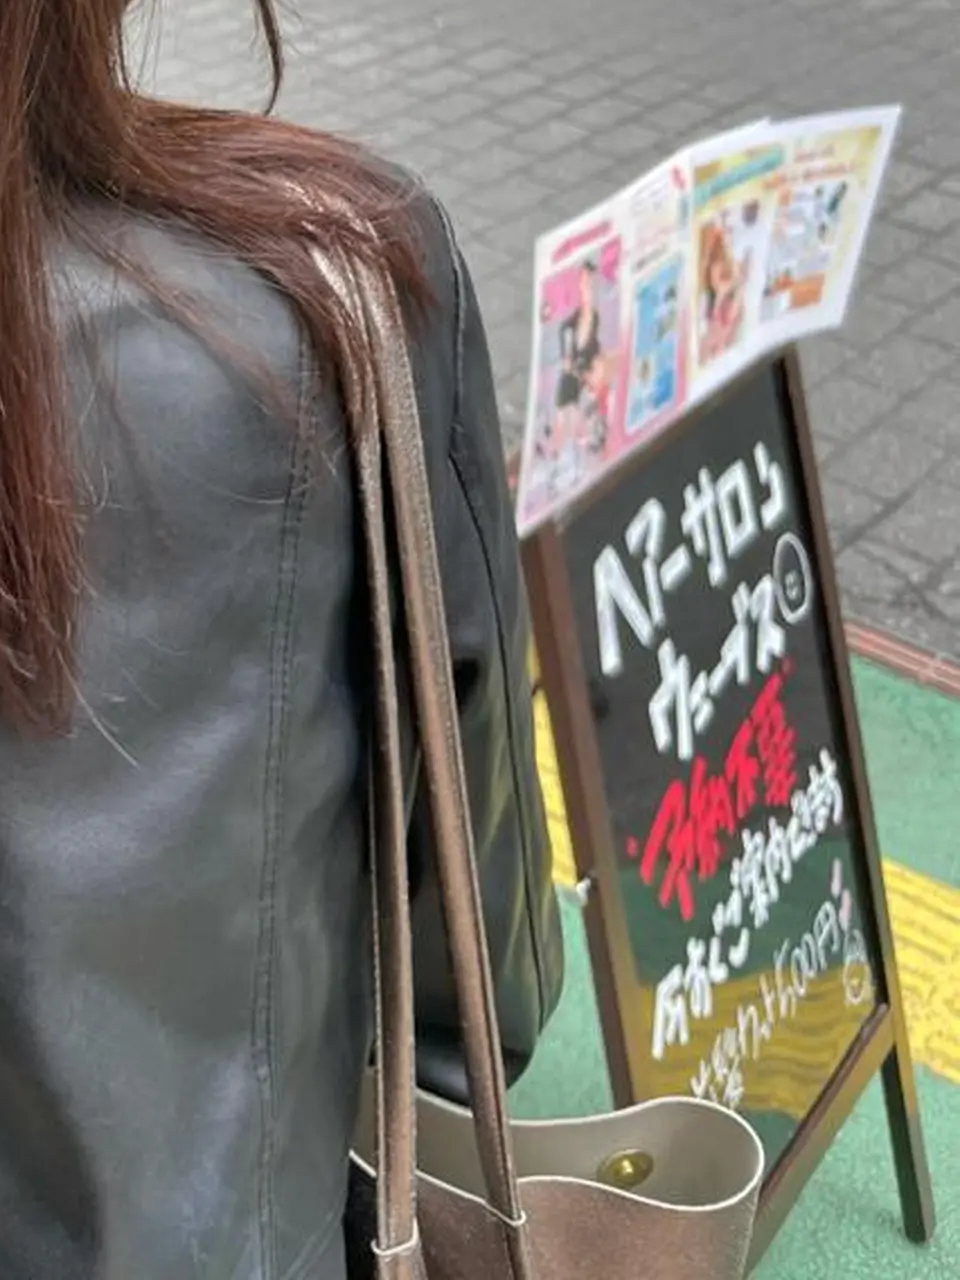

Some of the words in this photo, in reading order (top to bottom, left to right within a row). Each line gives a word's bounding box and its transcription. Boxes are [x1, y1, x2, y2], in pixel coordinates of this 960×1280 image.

[592, 441, 789, 677] ヘアーサロン
